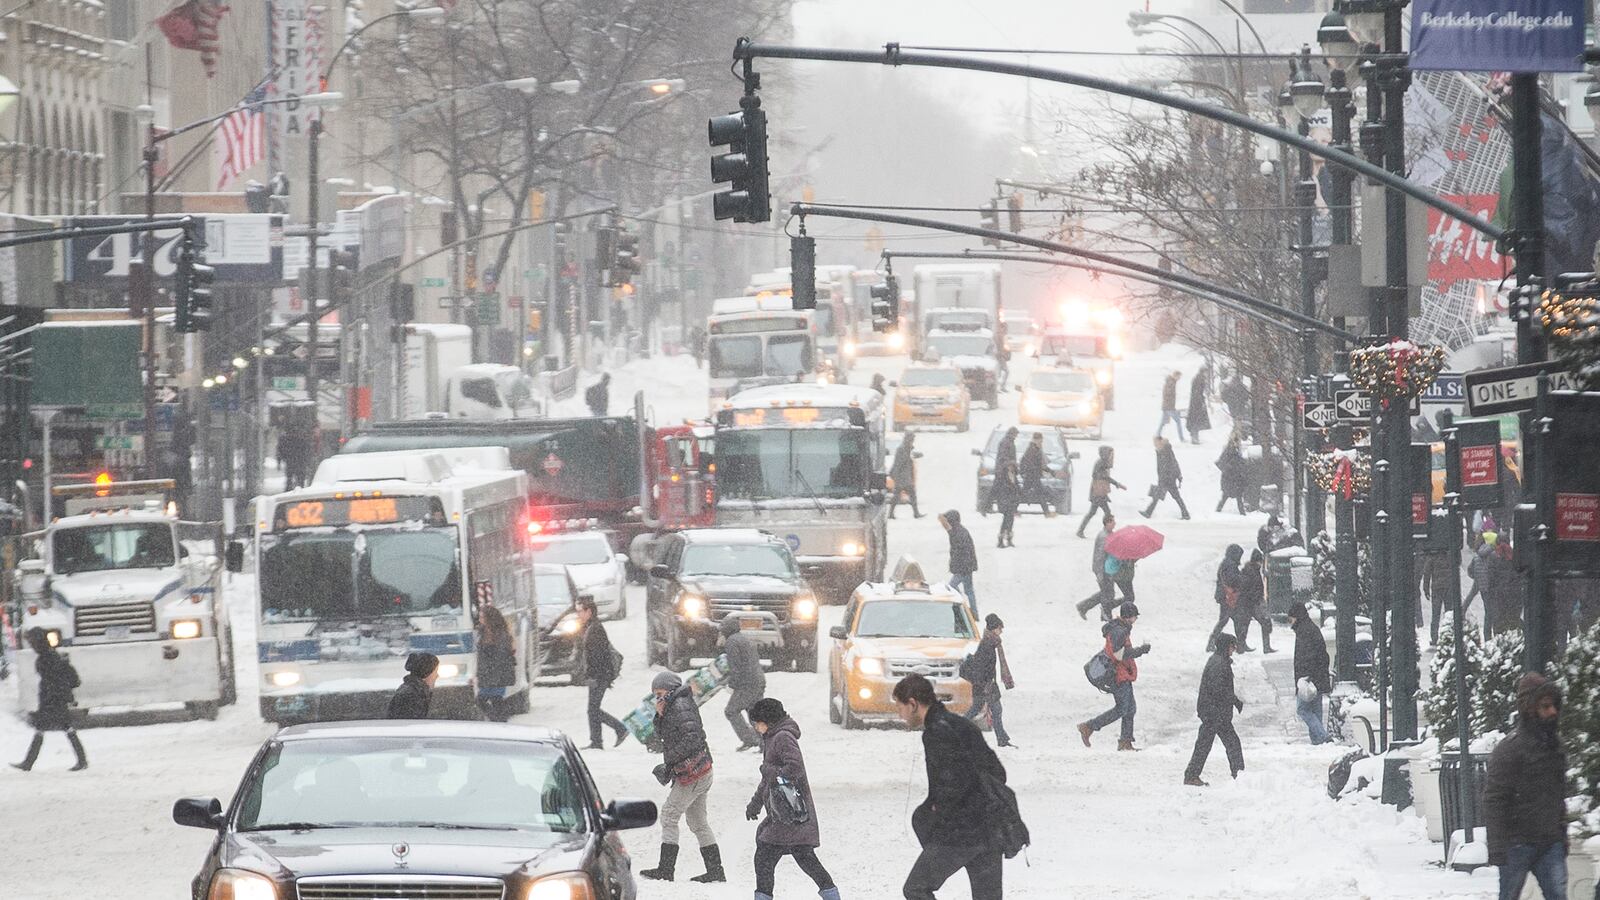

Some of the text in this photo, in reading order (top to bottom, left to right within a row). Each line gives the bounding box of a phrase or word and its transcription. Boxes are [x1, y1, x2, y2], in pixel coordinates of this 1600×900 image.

[1420, 11, 1573, 33] BerkeleyCollege.edu
[87, 222, 185, 277] 47
[1447, 381, 1464, 397] St
[1478, 382, 1518, 403] ONE
[1345, 400, 1371, 410] ONE
[1466, 459, 1491, 469] ANYTIME
[1563, 511, 1594, 521] ANYTIME
